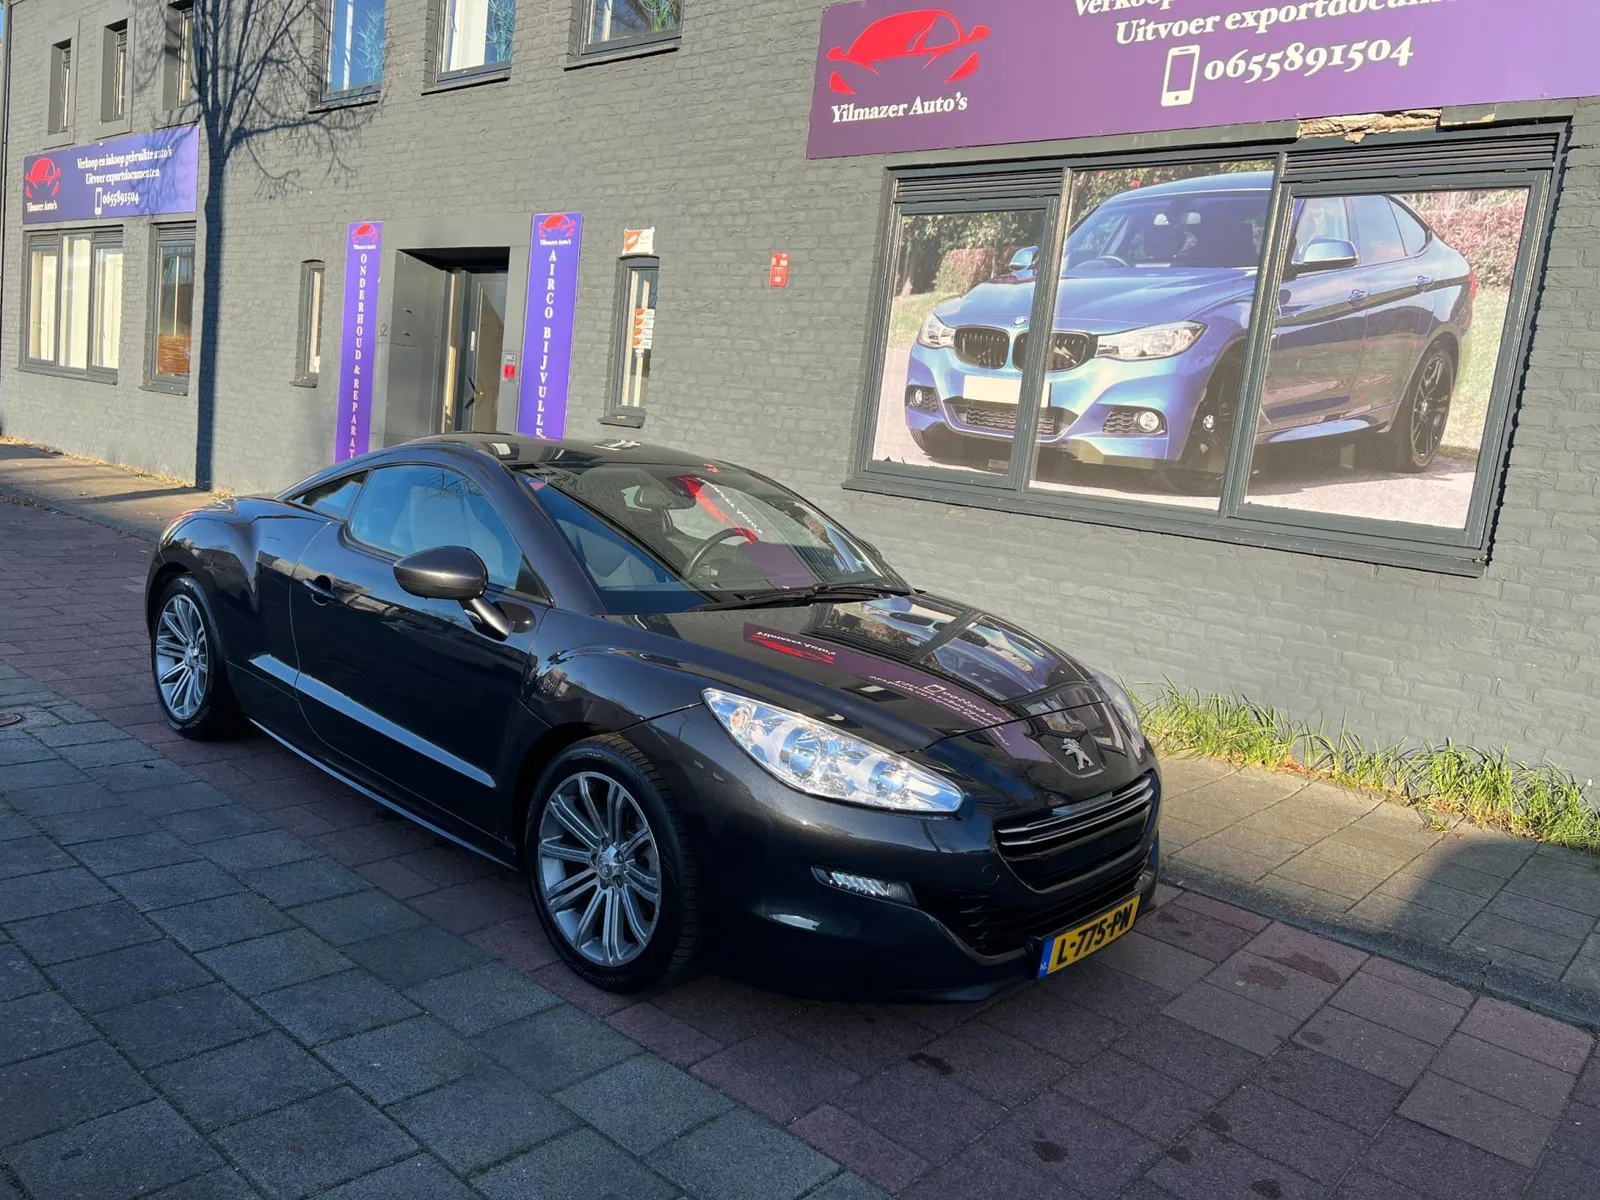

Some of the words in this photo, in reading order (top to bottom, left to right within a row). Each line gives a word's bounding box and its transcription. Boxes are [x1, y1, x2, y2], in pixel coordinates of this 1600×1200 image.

[1116, 15, 1221, 44] Uitvoer
[1204, 37, 1413, 84] 0655891504
[831, 102, 908, 123] Yilmazer
[908, 91, 968, 115] Auto's
[102, 190, 140, 207] 0655891504
[544, 249, 557, 319] AIRCO
[355, 253, 368, 360] ONDERHOUD
[353, 365, 361, 375] &
[1056, 903, 1134, 965] L-775-PN
